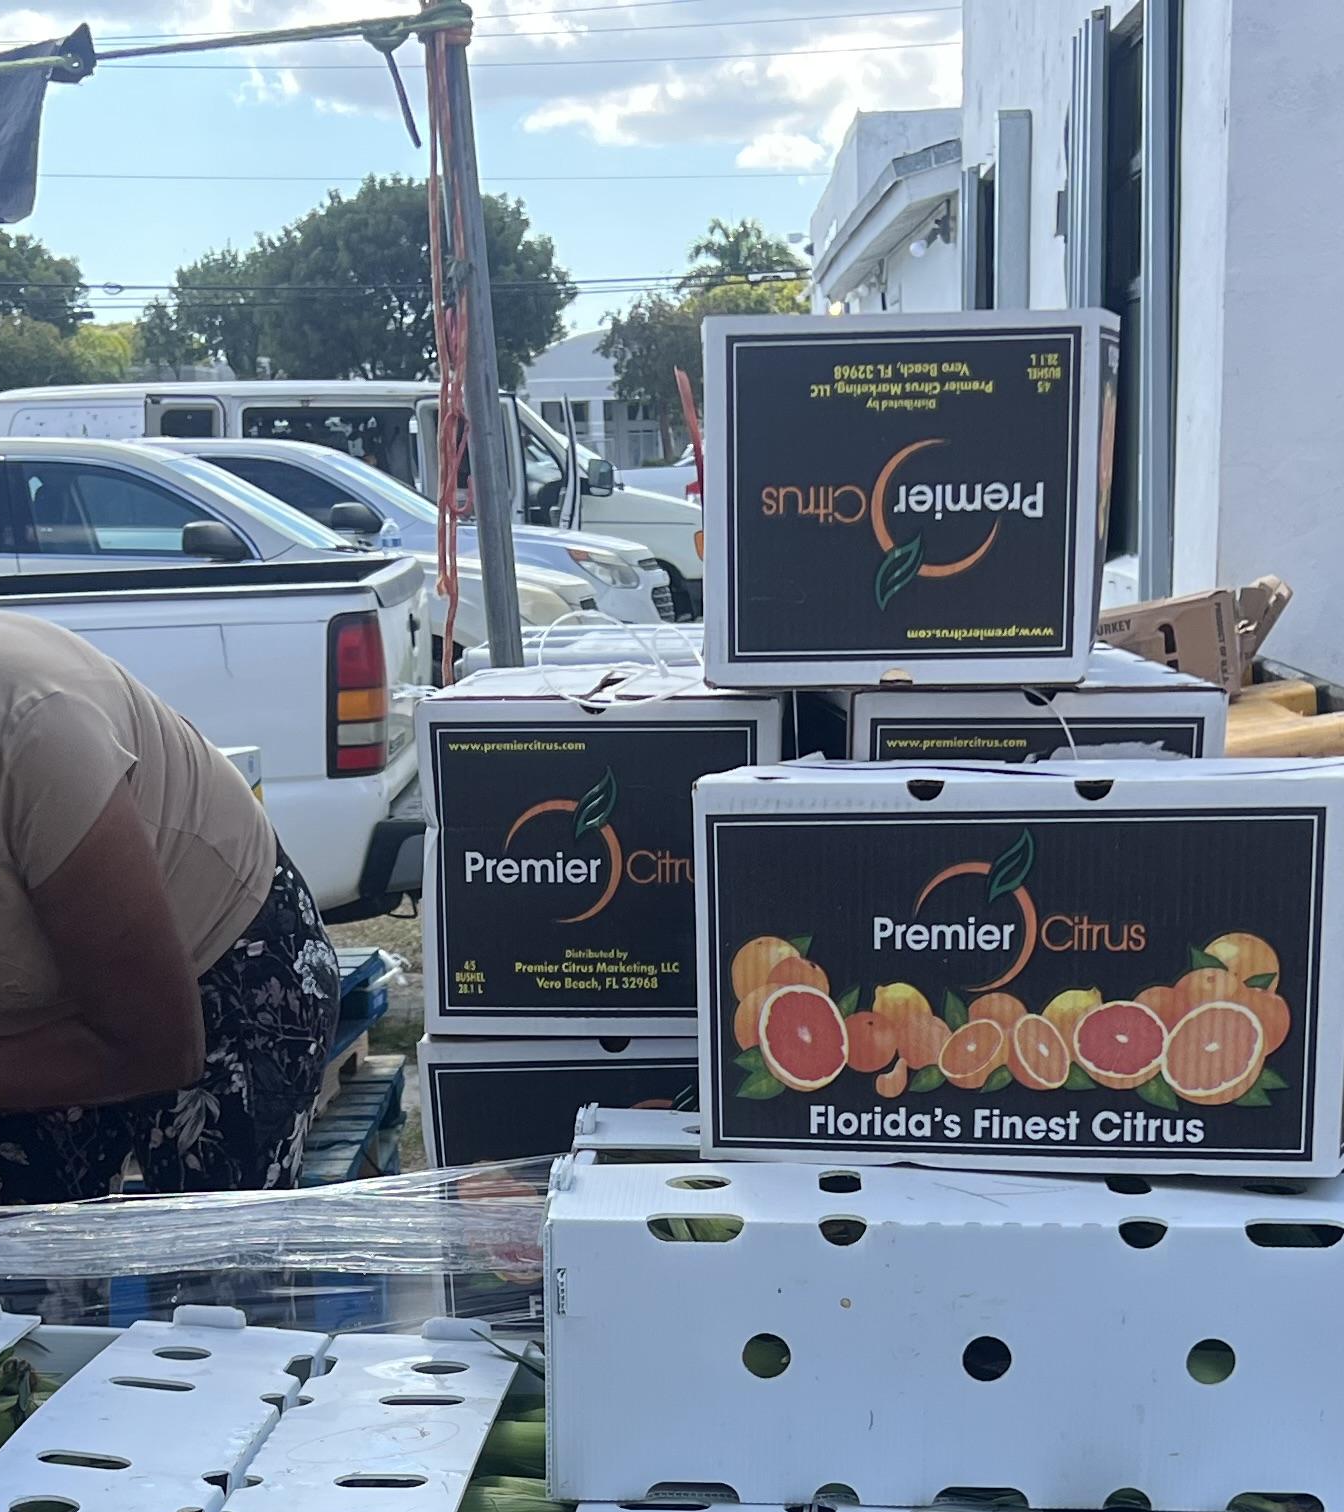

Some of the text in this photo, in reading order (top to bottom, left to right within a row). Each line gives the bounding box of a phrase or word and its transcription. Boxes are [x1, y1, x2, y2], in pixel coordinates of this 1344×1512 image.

[833, 362, 970, 380] Vero Beach, FL 32968
[1026, 367, 1061, 381] BUSHEL
[810, 381, 994, 398] Premier Citrus Marketing, LLC
[865, 399, 937, 411] Distributed by
[760, 480, 1045, 524] Premier Citrus
[906, 627, 1054, 640] www.premiercitrus.com
[1096, 619, 1132, 637] URKEY
[448, 740, 586, 753] www.premiercitrus.com
[886, 736, 1028, 750] www.premiercitrus.com
[464, 849, 694, 885] Premier Citru
[871, 914, 1147, 952] Premier Citrus
[564, 949, 629, 961] Distributed by
[514, 961, 680, 976] Premier Citrus Marketing, LLC
[455, 971, 486, 983] BUSHEL
[535, 977, 659, 991] Vero Beach, FL 32968
[457, 982, 475, 994] 28.1
[809, 1104, 1205, 1144] Florida's Finest Citrus
